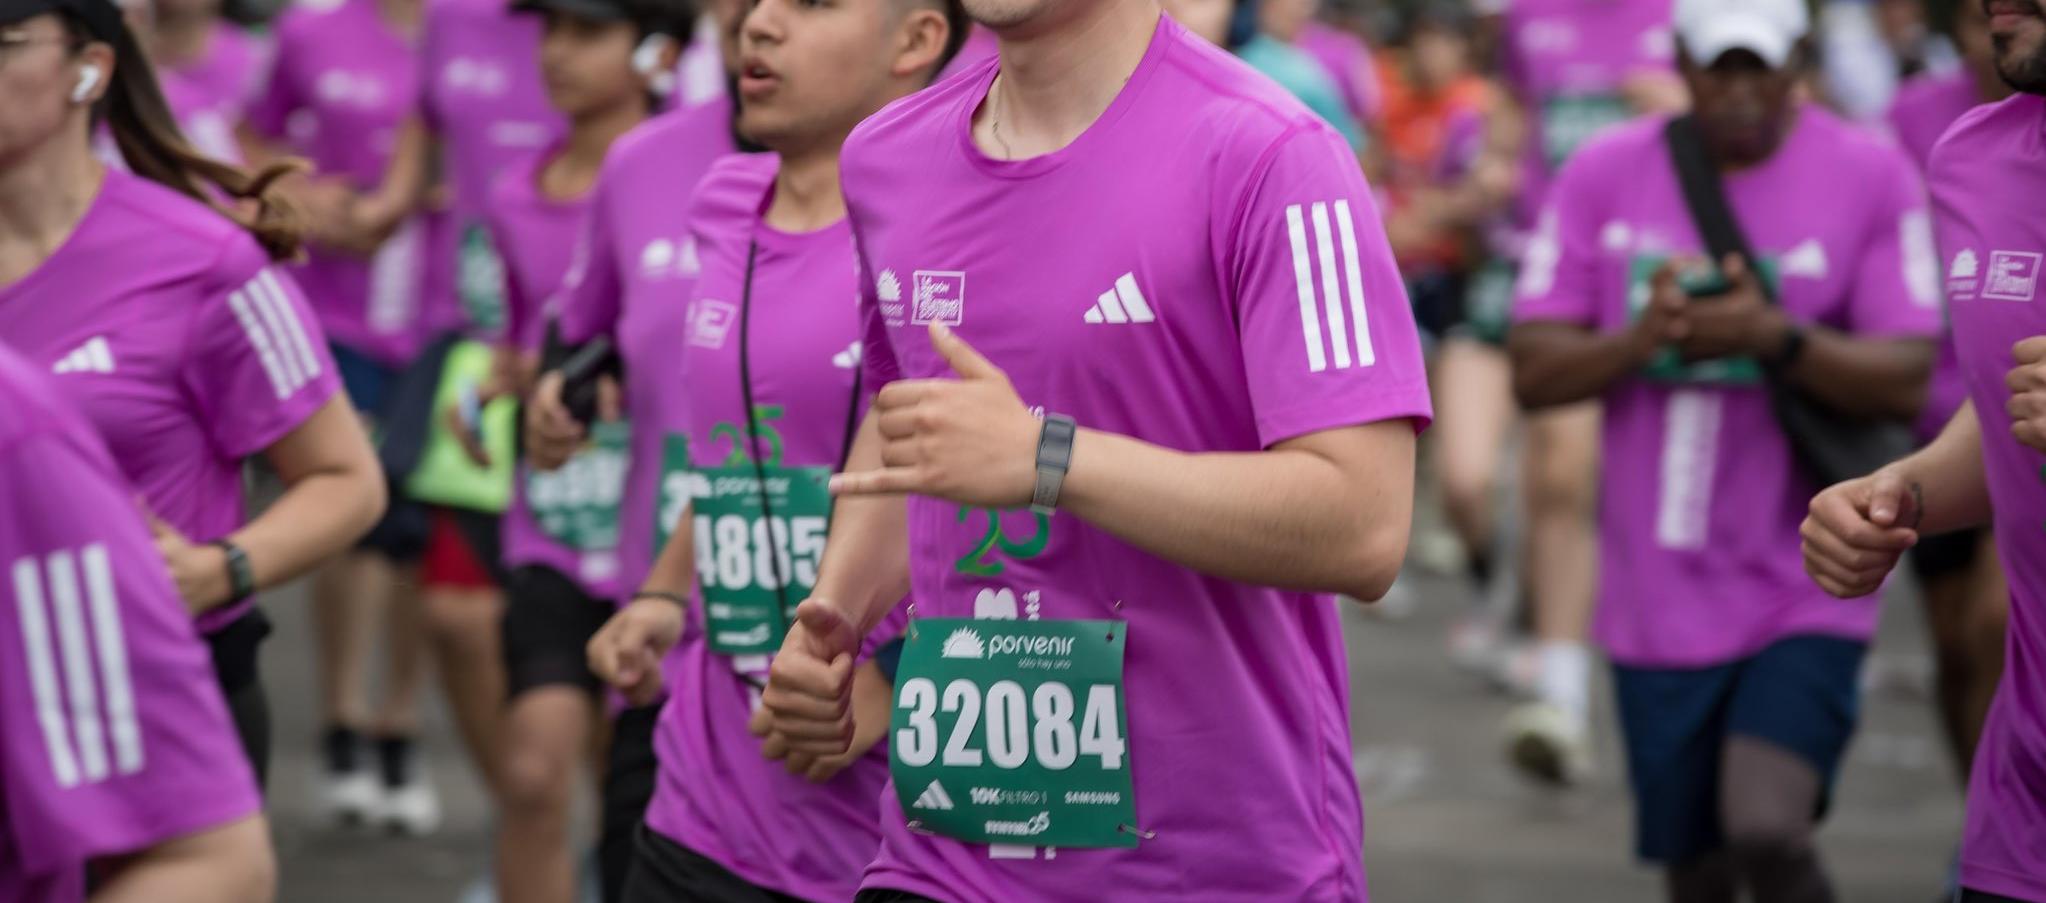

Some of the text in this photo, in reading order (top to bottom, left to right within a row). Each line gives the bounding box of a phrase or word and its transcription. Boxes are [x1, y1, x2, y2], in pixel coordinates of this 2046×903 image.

[988, 634, 1076, 660] porvenir
[896, 677, 1126, 770] 32084
[1064, 790, 1121, 805] SAMSUNG
